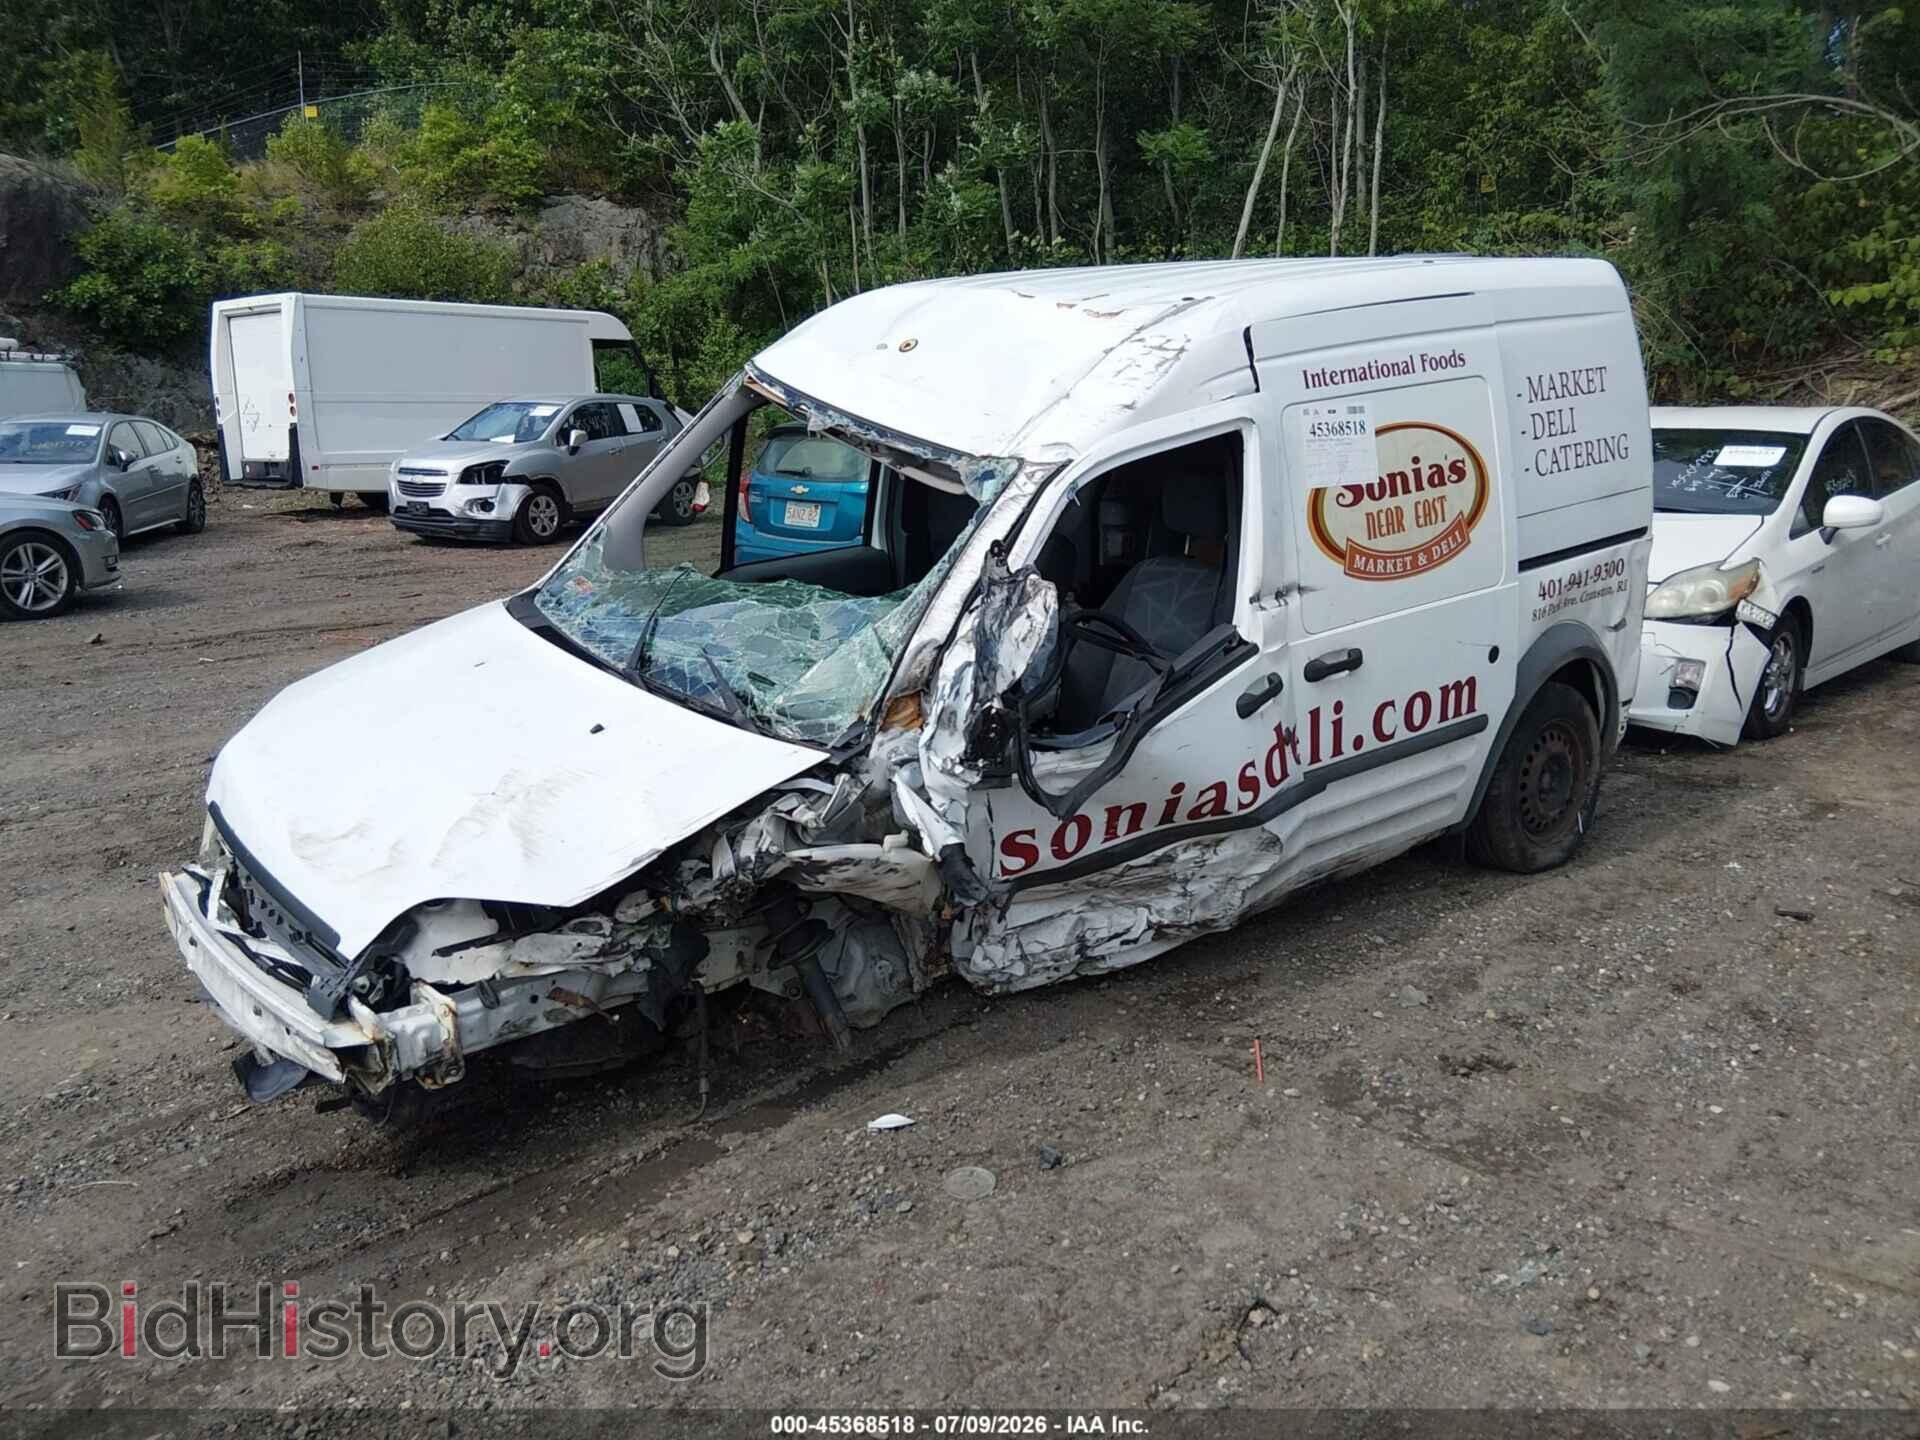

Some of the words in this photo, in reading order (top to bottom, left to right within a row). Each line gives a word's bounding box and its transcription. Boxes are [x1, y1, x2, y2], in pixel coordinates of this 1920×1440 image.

[1302, 354, 1416, 390] International
[1420, 349, 1467, 373] Foods
[1526, 366, 1607, 404] MARKET
[1309, 420, 1367, 438] 45368518
[1530, 407, 1577, 440] DELI
[1535, 433, 1629, 477] CATERING
[1365, 505, 1406, 540] NEAR
[1414, 495, 1447, 528] EAST
[1353, 554, 1413, 574] MARKET
[1417, 552, 1428, 566] &
[1431, 531, 1463, 560] DELI
[1538, 558, 1625, 600] 401-941-9300
